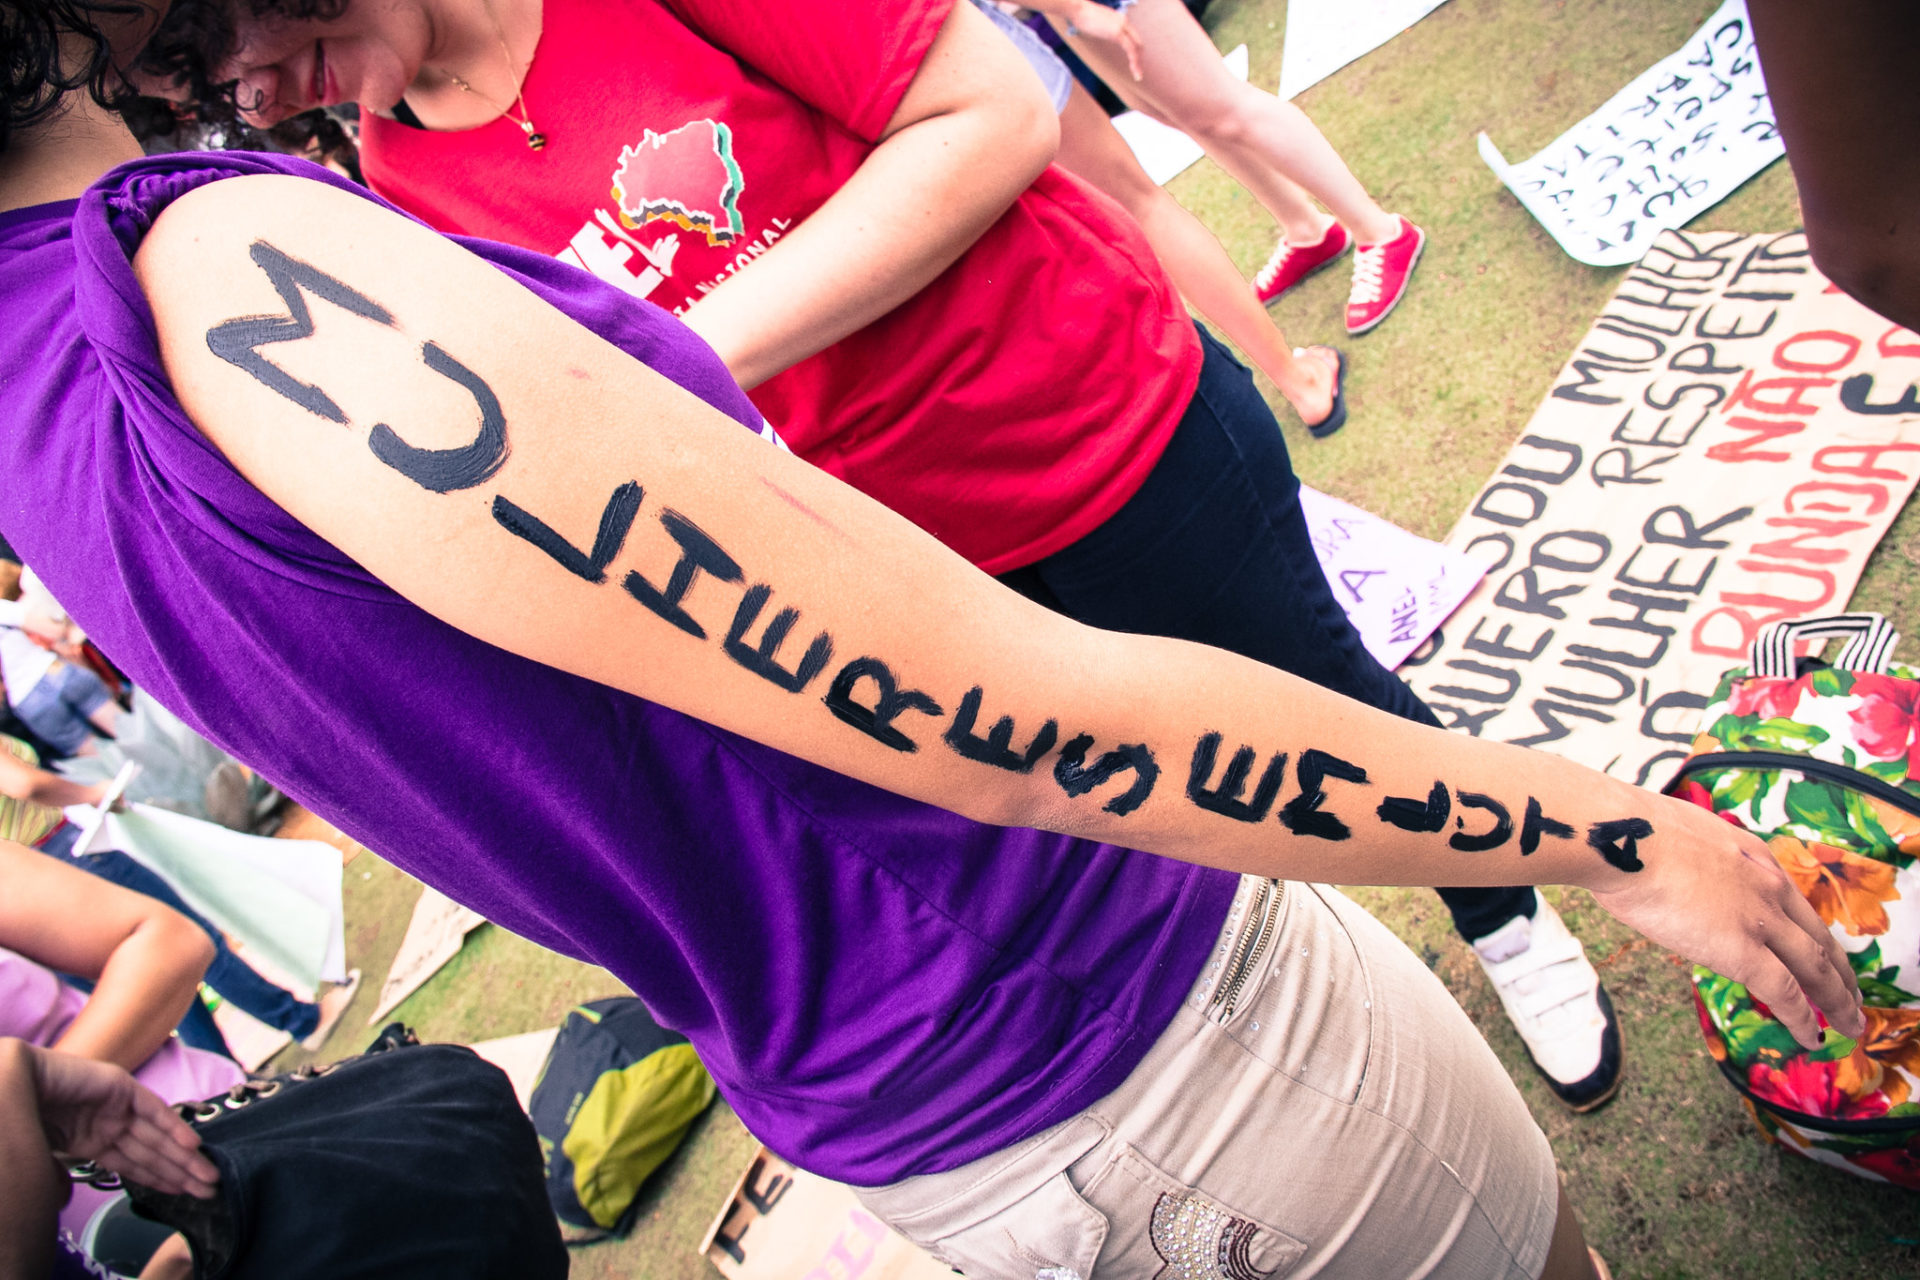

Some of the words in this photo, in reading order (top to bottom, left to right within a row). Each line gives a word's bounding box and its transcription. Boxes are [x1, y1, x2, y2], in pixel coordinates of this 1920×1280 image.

[1551, 228, 1751, 405] MULHER
[1590, 229, 1807, 487] RESPEITO
[206, 239, 1159, 816] MULHERES
[1186, 728, 1371, 841] EM
[1375, 779, 1656, 873] LUTA
[1504, 504, 1754, 748] MULHER
[1703, 329, 1863, 464] NÃO
[1690, 441, 1920, 660] BUNDA
